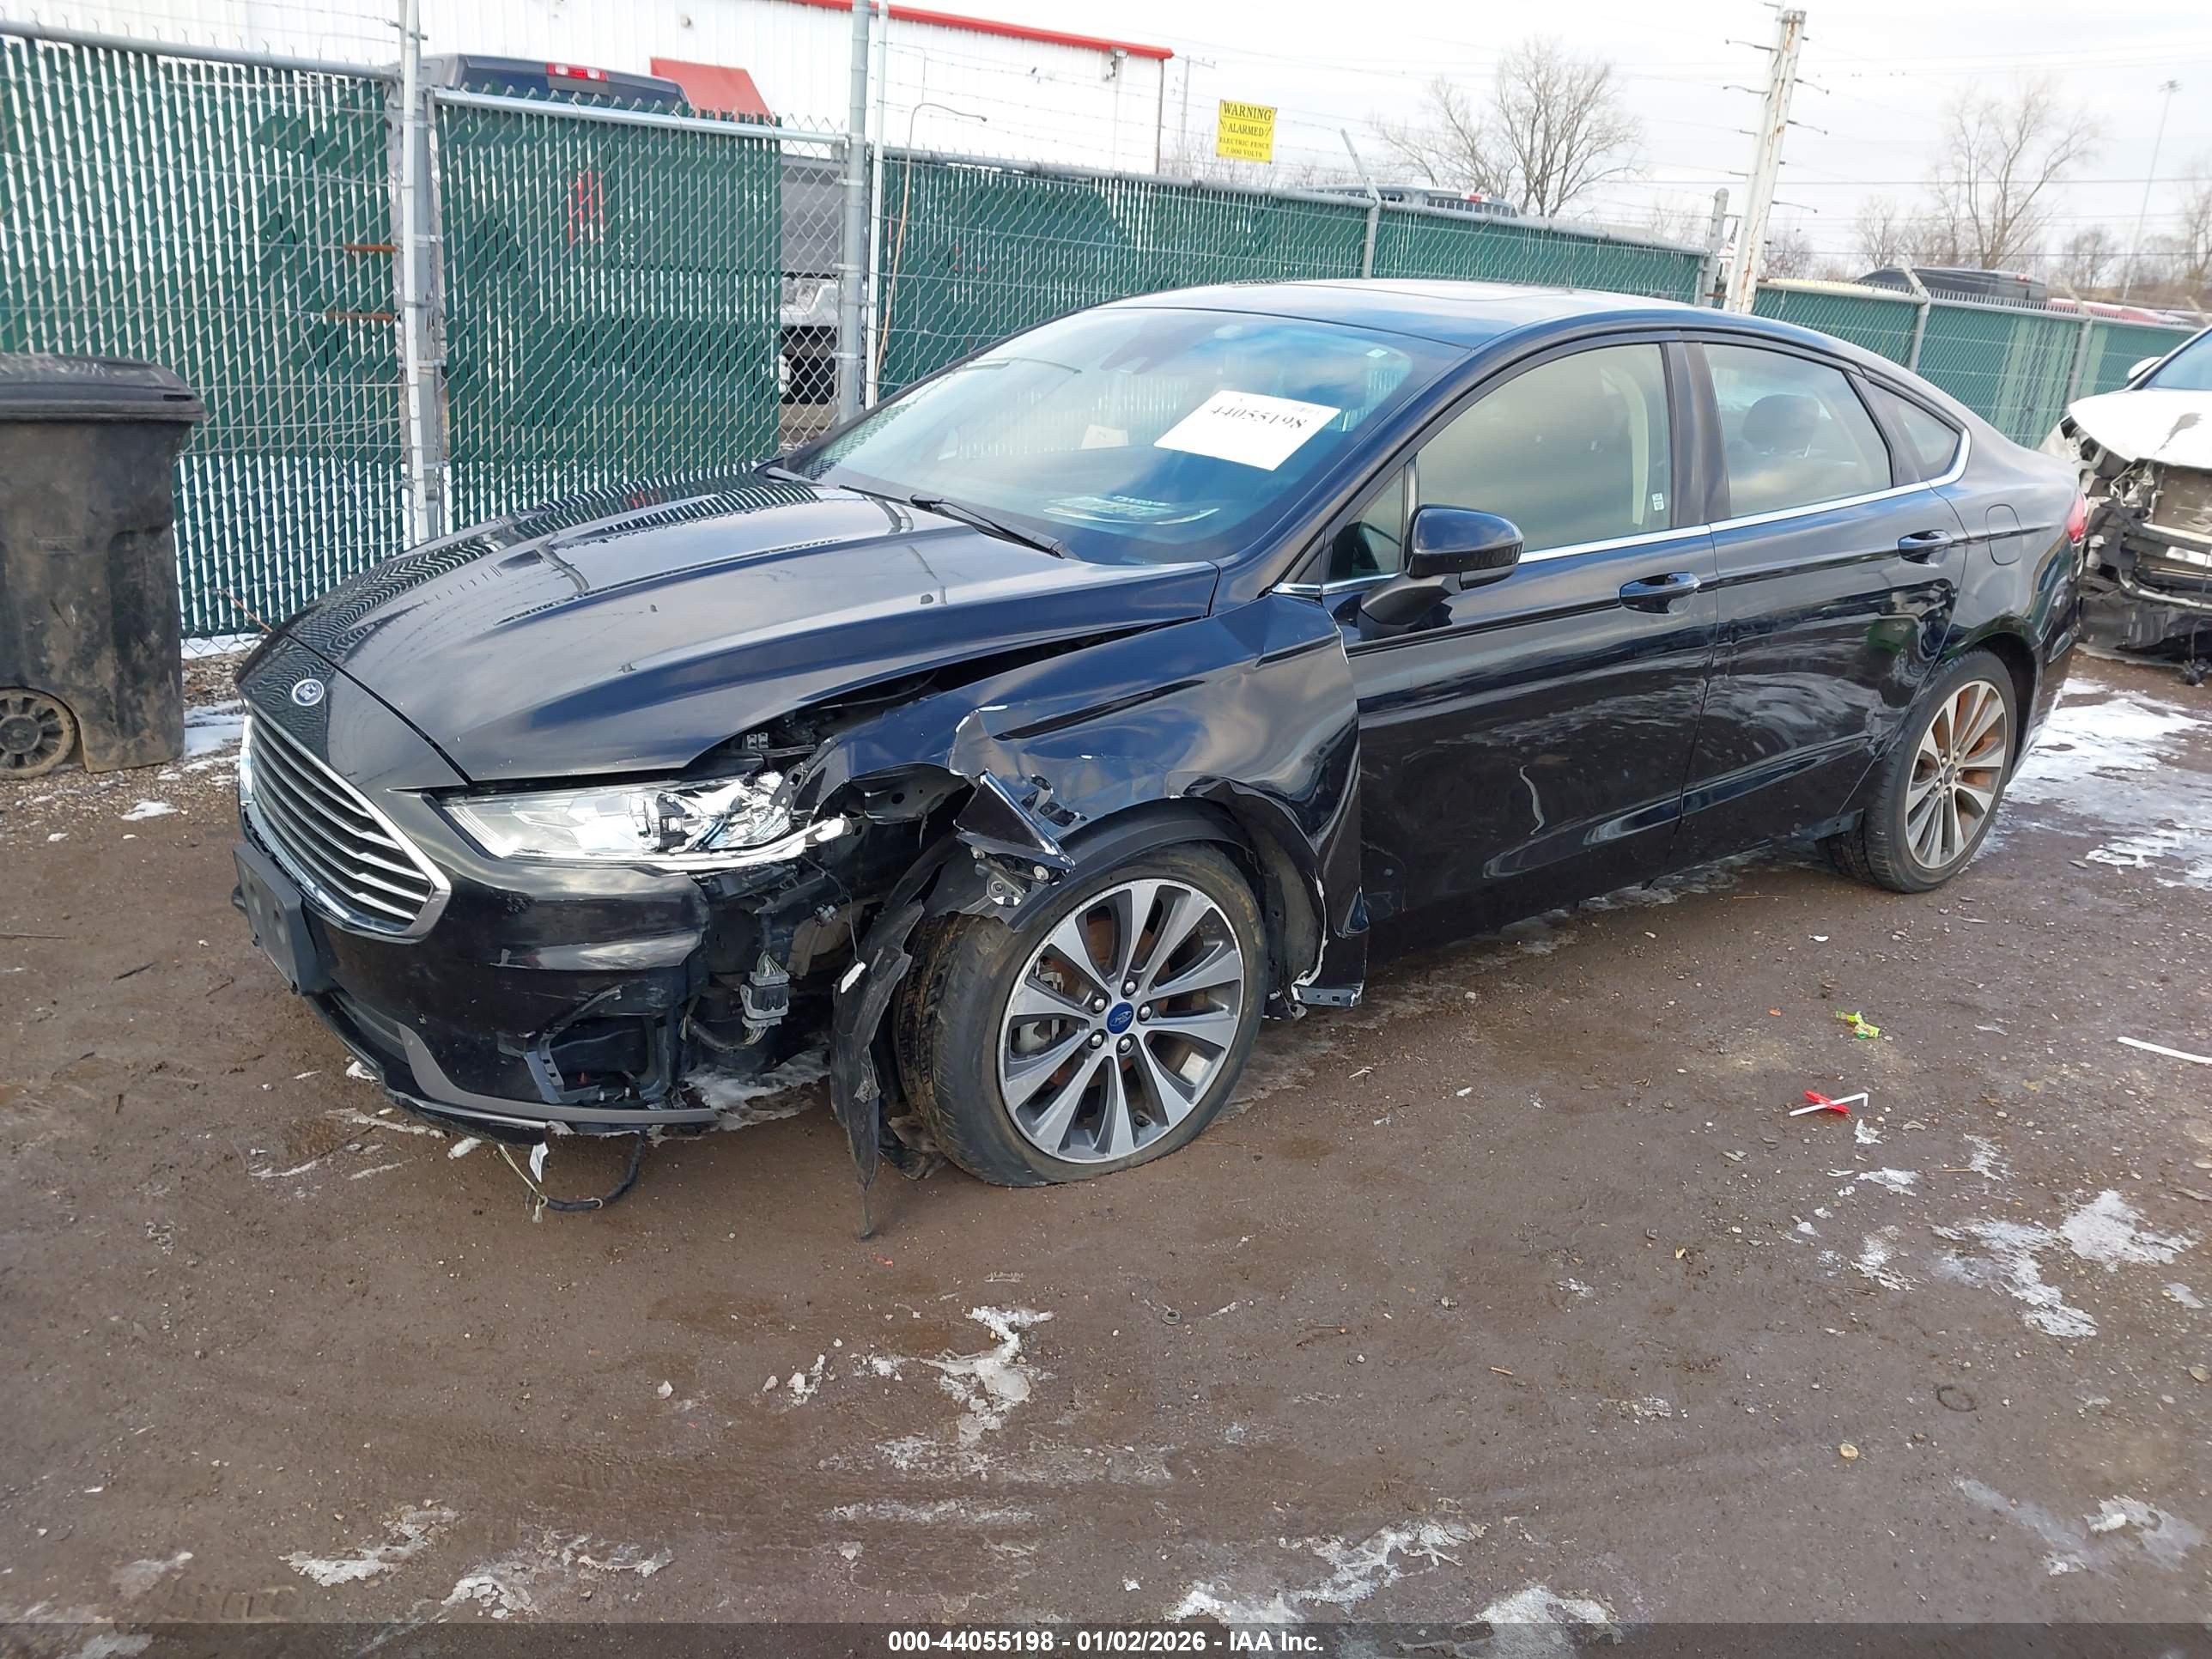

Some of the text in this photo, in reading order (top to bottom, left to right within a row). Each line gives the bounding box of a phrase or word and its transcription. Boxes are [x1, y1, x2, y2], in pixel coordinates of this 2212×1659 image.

[1223, 102, 1272, 121] WARNING
[1228, 123, 1264, 137] ALARMED
[1211, 405, 1307, 428] 44055198
